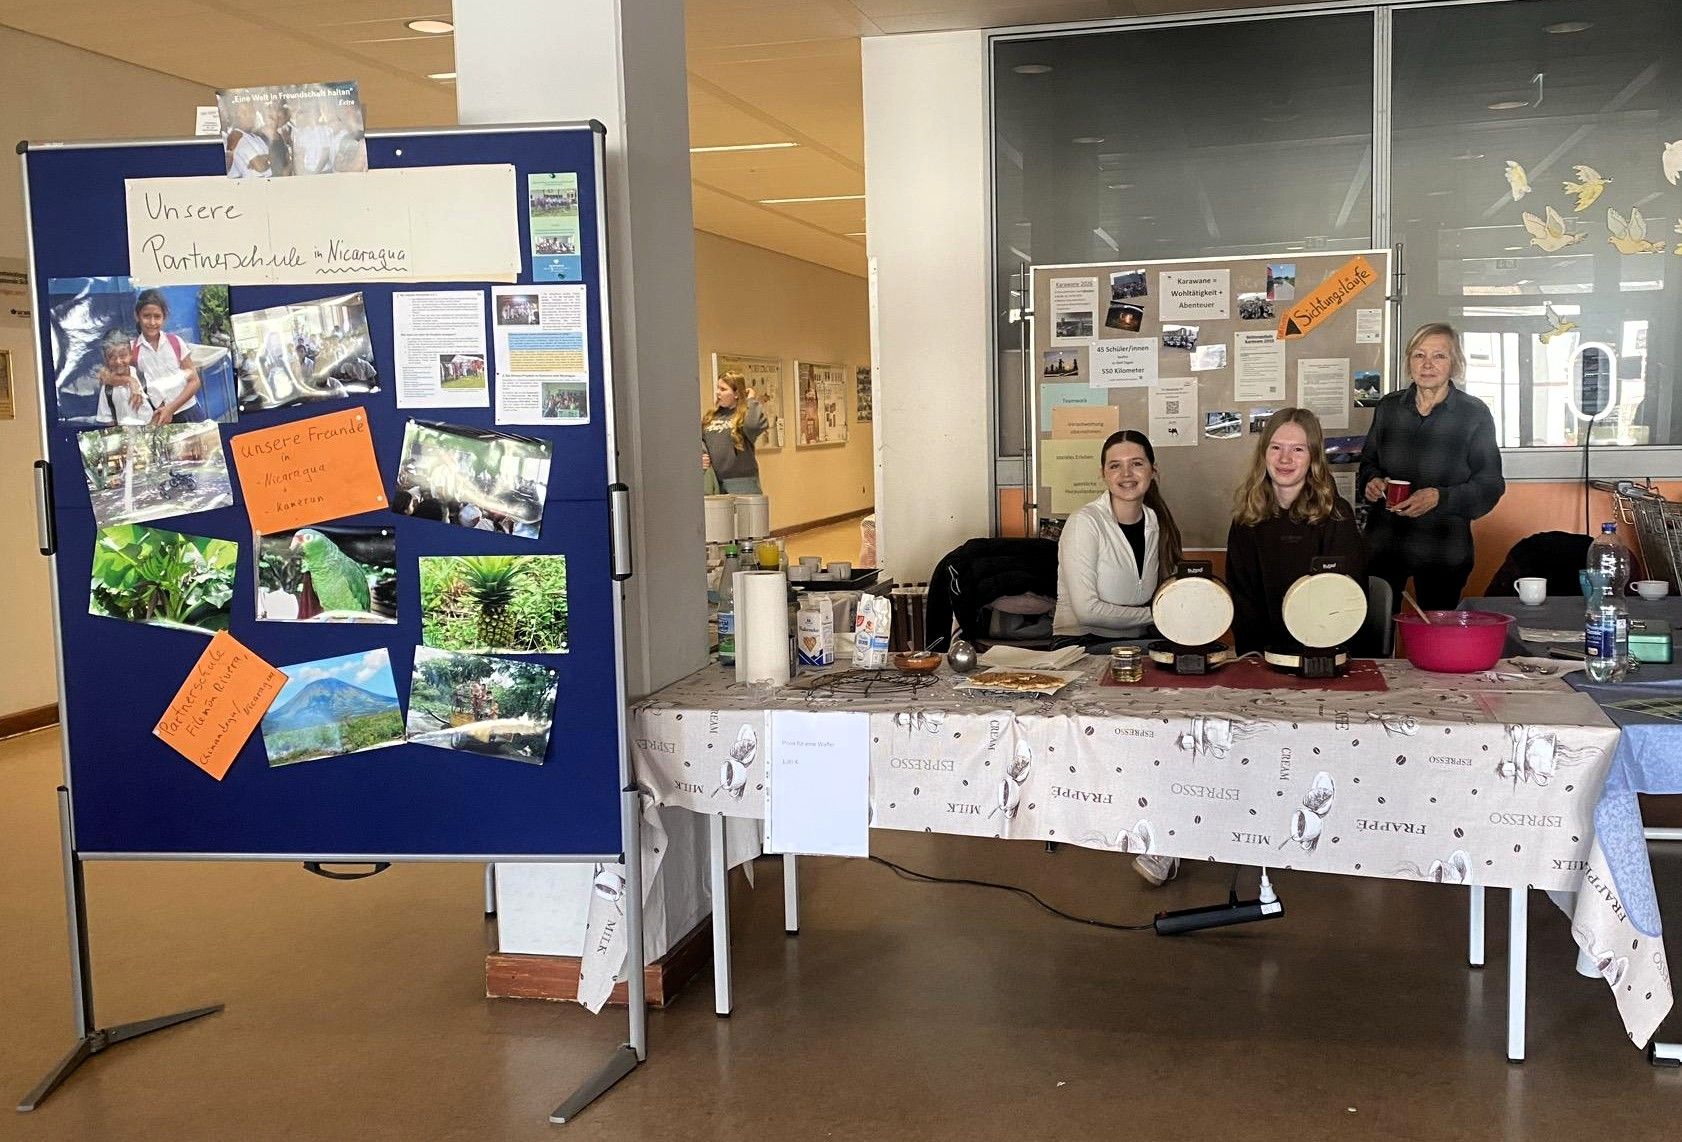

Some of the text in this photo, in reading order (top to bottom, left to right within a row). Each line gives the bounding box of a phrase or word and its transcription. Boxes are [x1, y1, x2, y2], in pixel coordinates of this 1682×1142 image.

[251, 93, 269, 101] Welt
[278, 90, 327, 100] Freundschaft
[145, 192, 243, 220] Unsere
[142, 234, 406, 273] Partnerschule in Nicaragua
[1171, 289, 1217, 297] Wohltätigkeit
[1294, 267, 1370, 327] Sichtungsläufe
[308, 419, 364, 442] Freunde
[281, 453, 290, 463] in
[264, 463, 326, 488] Nicaragua
[159, 649, 225, 736] Partnerschule
[709, 709, 719, 734] REAM
[988, 719, 1000, 751] CREAM
[1114, 727, 1155, 738] ESPRESSO
[890, 757, 954, 771] ESPRESSO
[1279, 747, 1292, 781] CREAM
[1428, 756, 1473, 766] ESPRESSO
[1051, 785, 1113, 804] FRAPPÉ
[1170, 782, 1240, 801] ESPRESSO
[1356, 818, 1427, 835] FRAPPÉ
[1489, 811, 1563, 828] ESPRESSO
